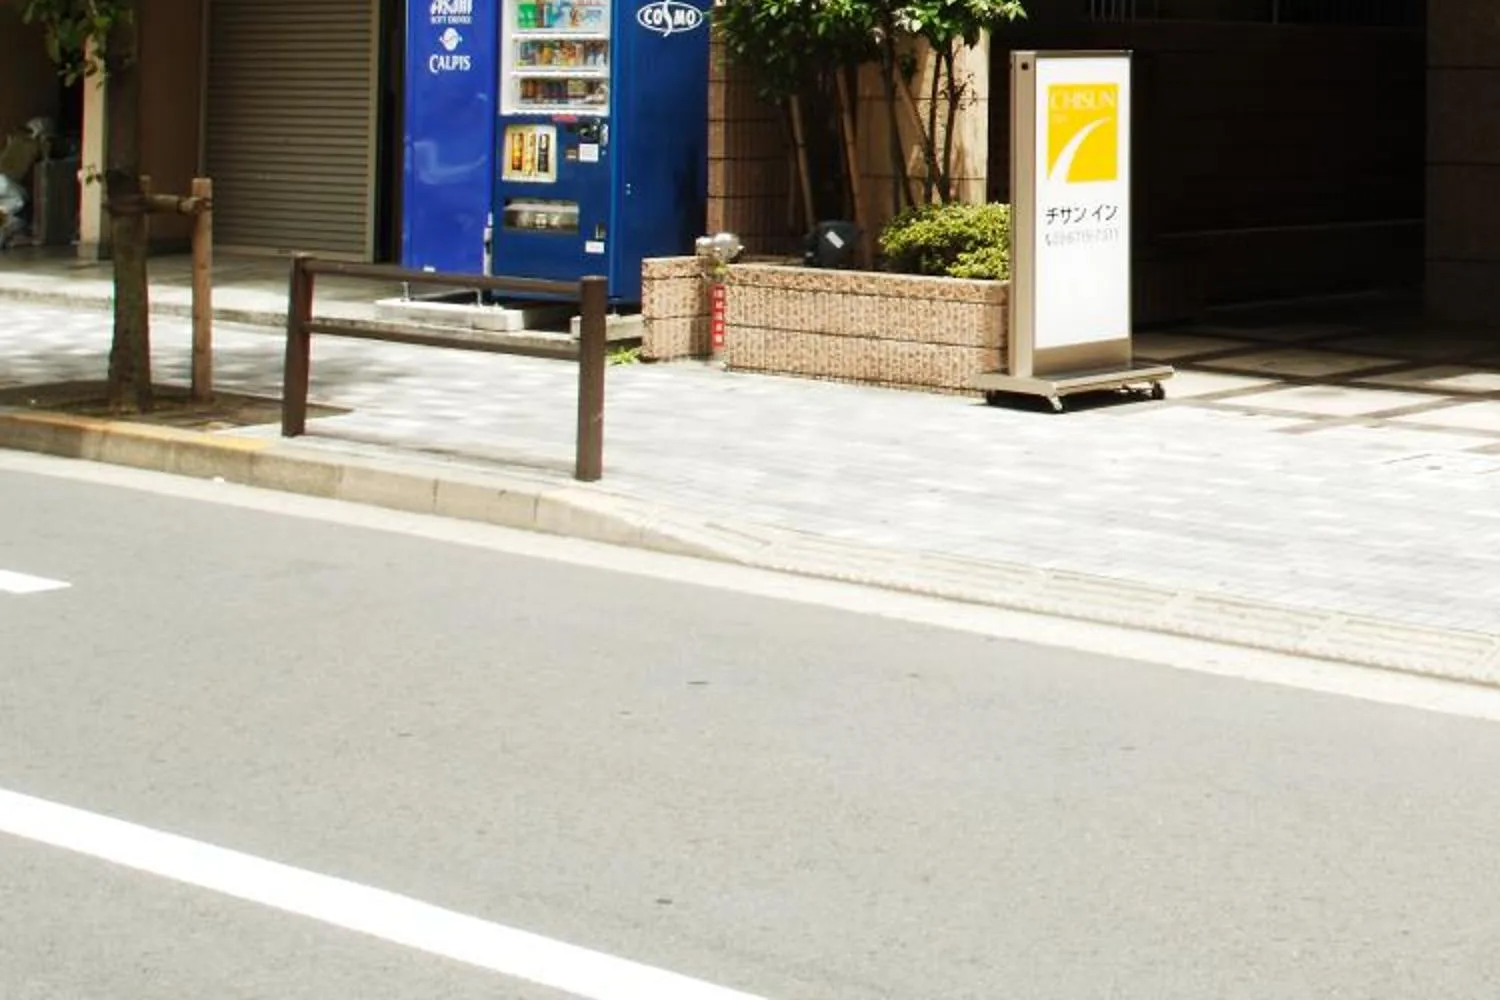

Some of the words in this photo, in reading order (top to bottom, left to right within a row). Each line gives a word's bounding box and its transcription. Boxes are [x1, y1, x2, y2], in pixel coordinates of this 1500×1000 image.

[429, 54, 471, 73] CALPIS
[1046, 207, 1087, 225] チサン
[1091, 204, 1119, 222] イン
